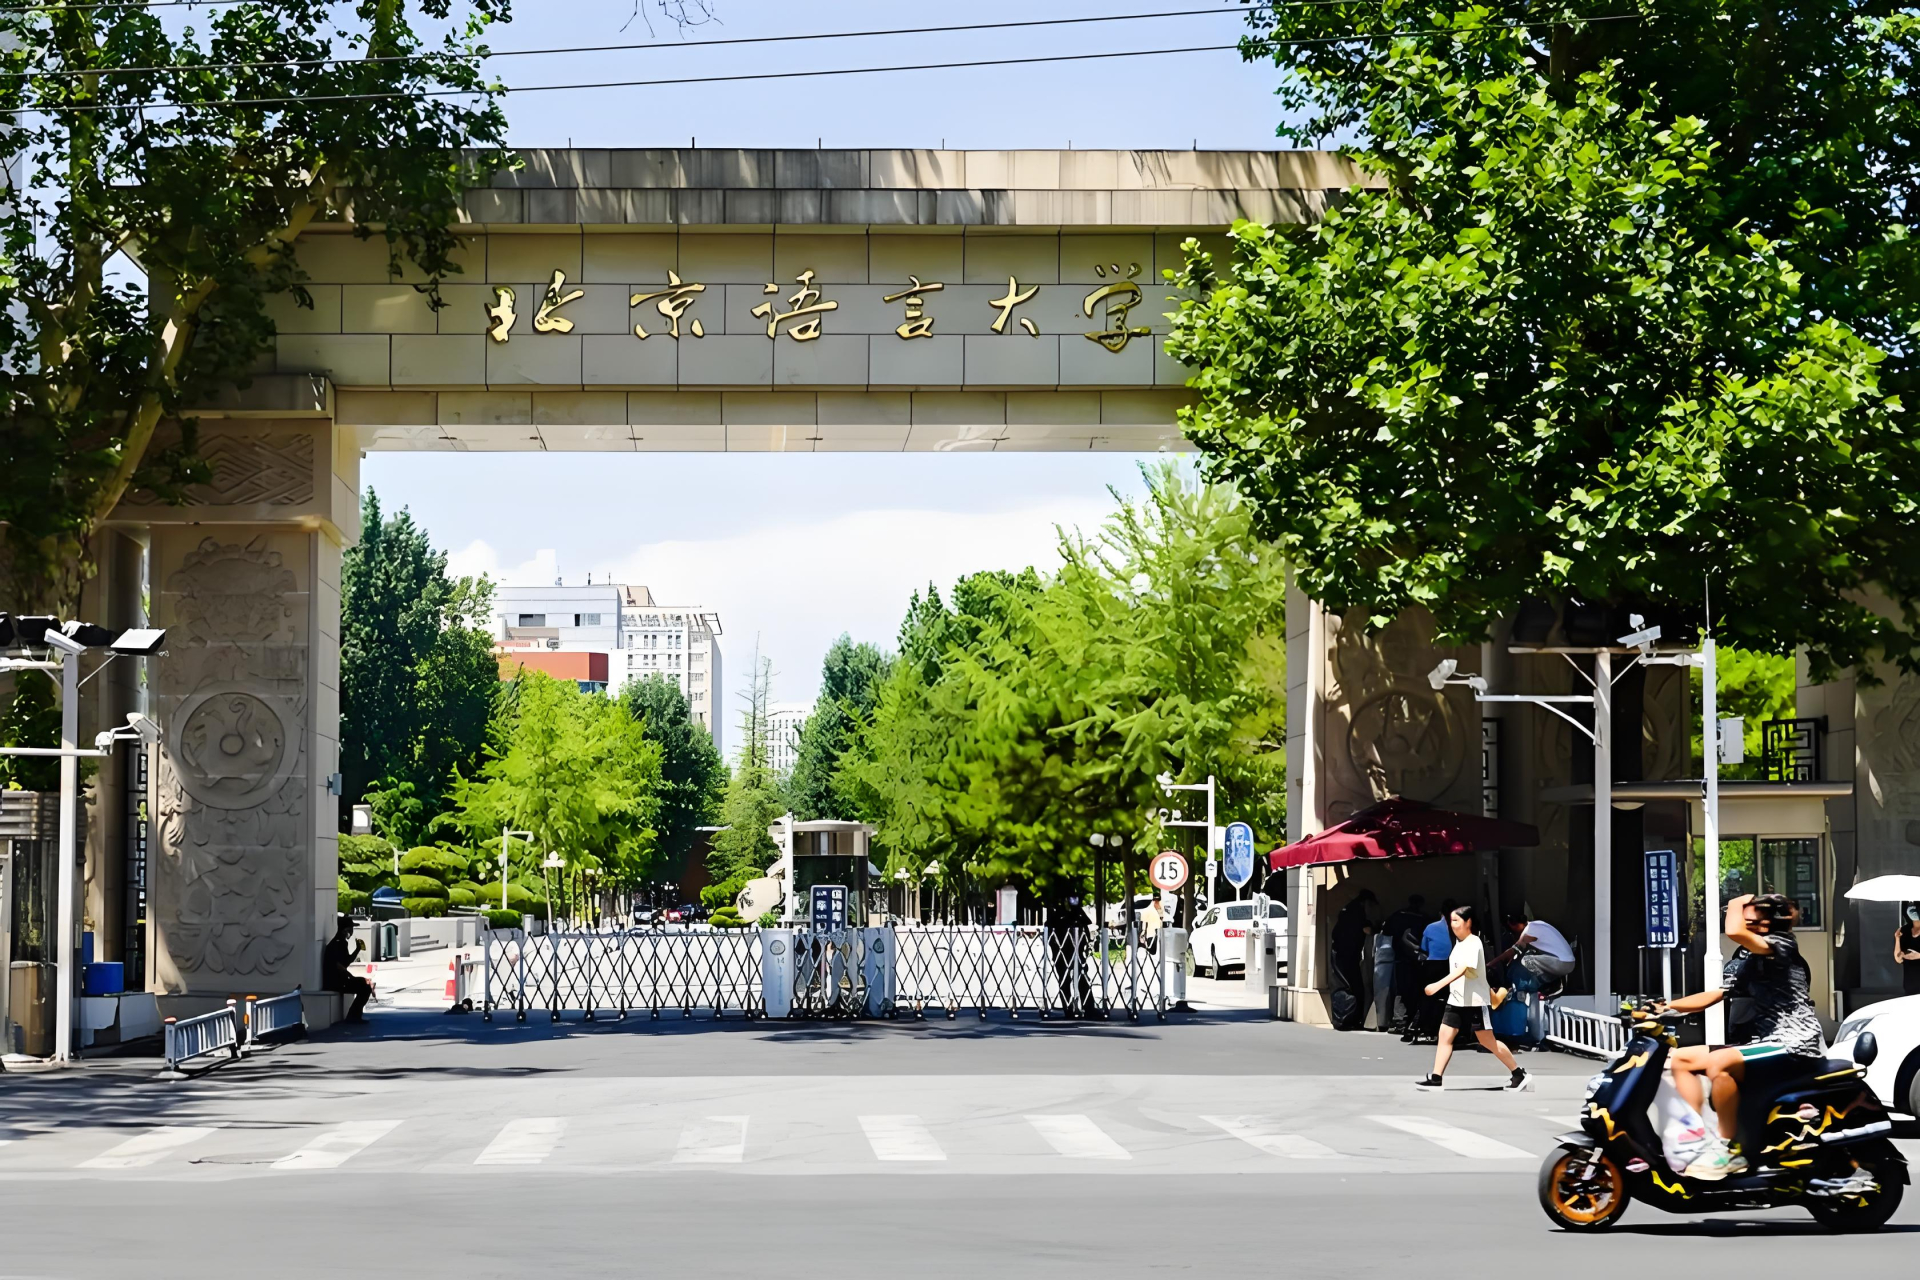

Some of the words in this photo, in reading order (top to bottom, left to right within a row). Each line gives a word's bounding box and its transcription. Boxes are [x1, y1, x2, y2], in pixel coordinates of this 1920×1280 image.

[484, 263, 1152, 353] 北京语言大学
[1158, 861, 1178, 880] 15
